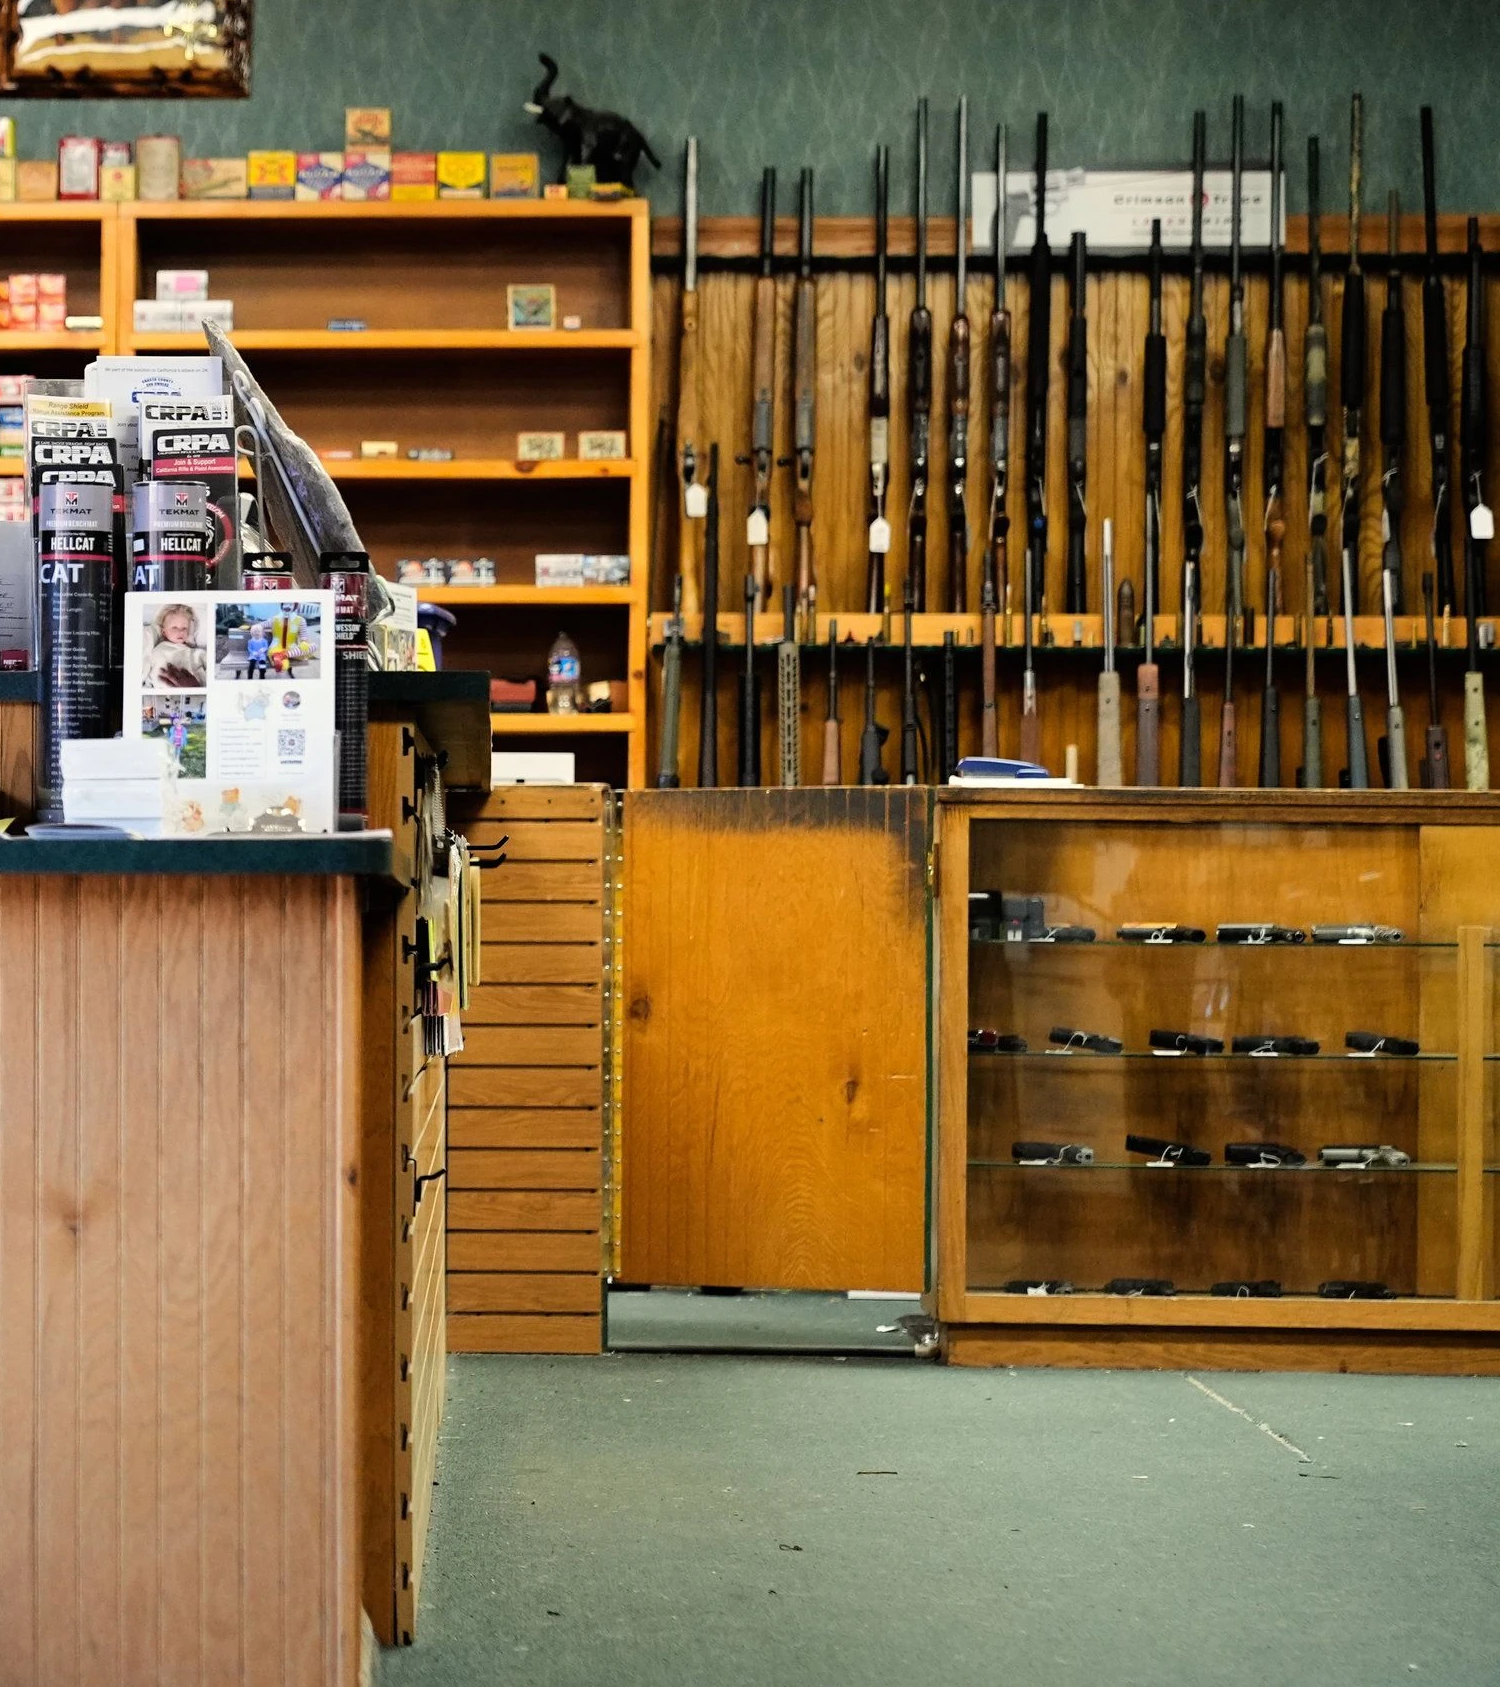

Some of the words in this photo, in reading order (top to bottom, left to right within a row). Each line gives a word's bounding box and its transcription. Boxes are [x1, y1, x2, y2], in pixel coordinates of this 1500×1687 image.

[145, 405, 209, 420] CRPA
[31, 420, 95, 437] CRPA
[157, 433, 230, 452] CRPA
[35, 444, 113, 464] CRPA
[193, 458, 216, 467] Support
[159, 508, 200, 516] TEKMAT
[51, 537, 95, 551] HELLCAT
[160, 537, 202, 552] HELLCAT
